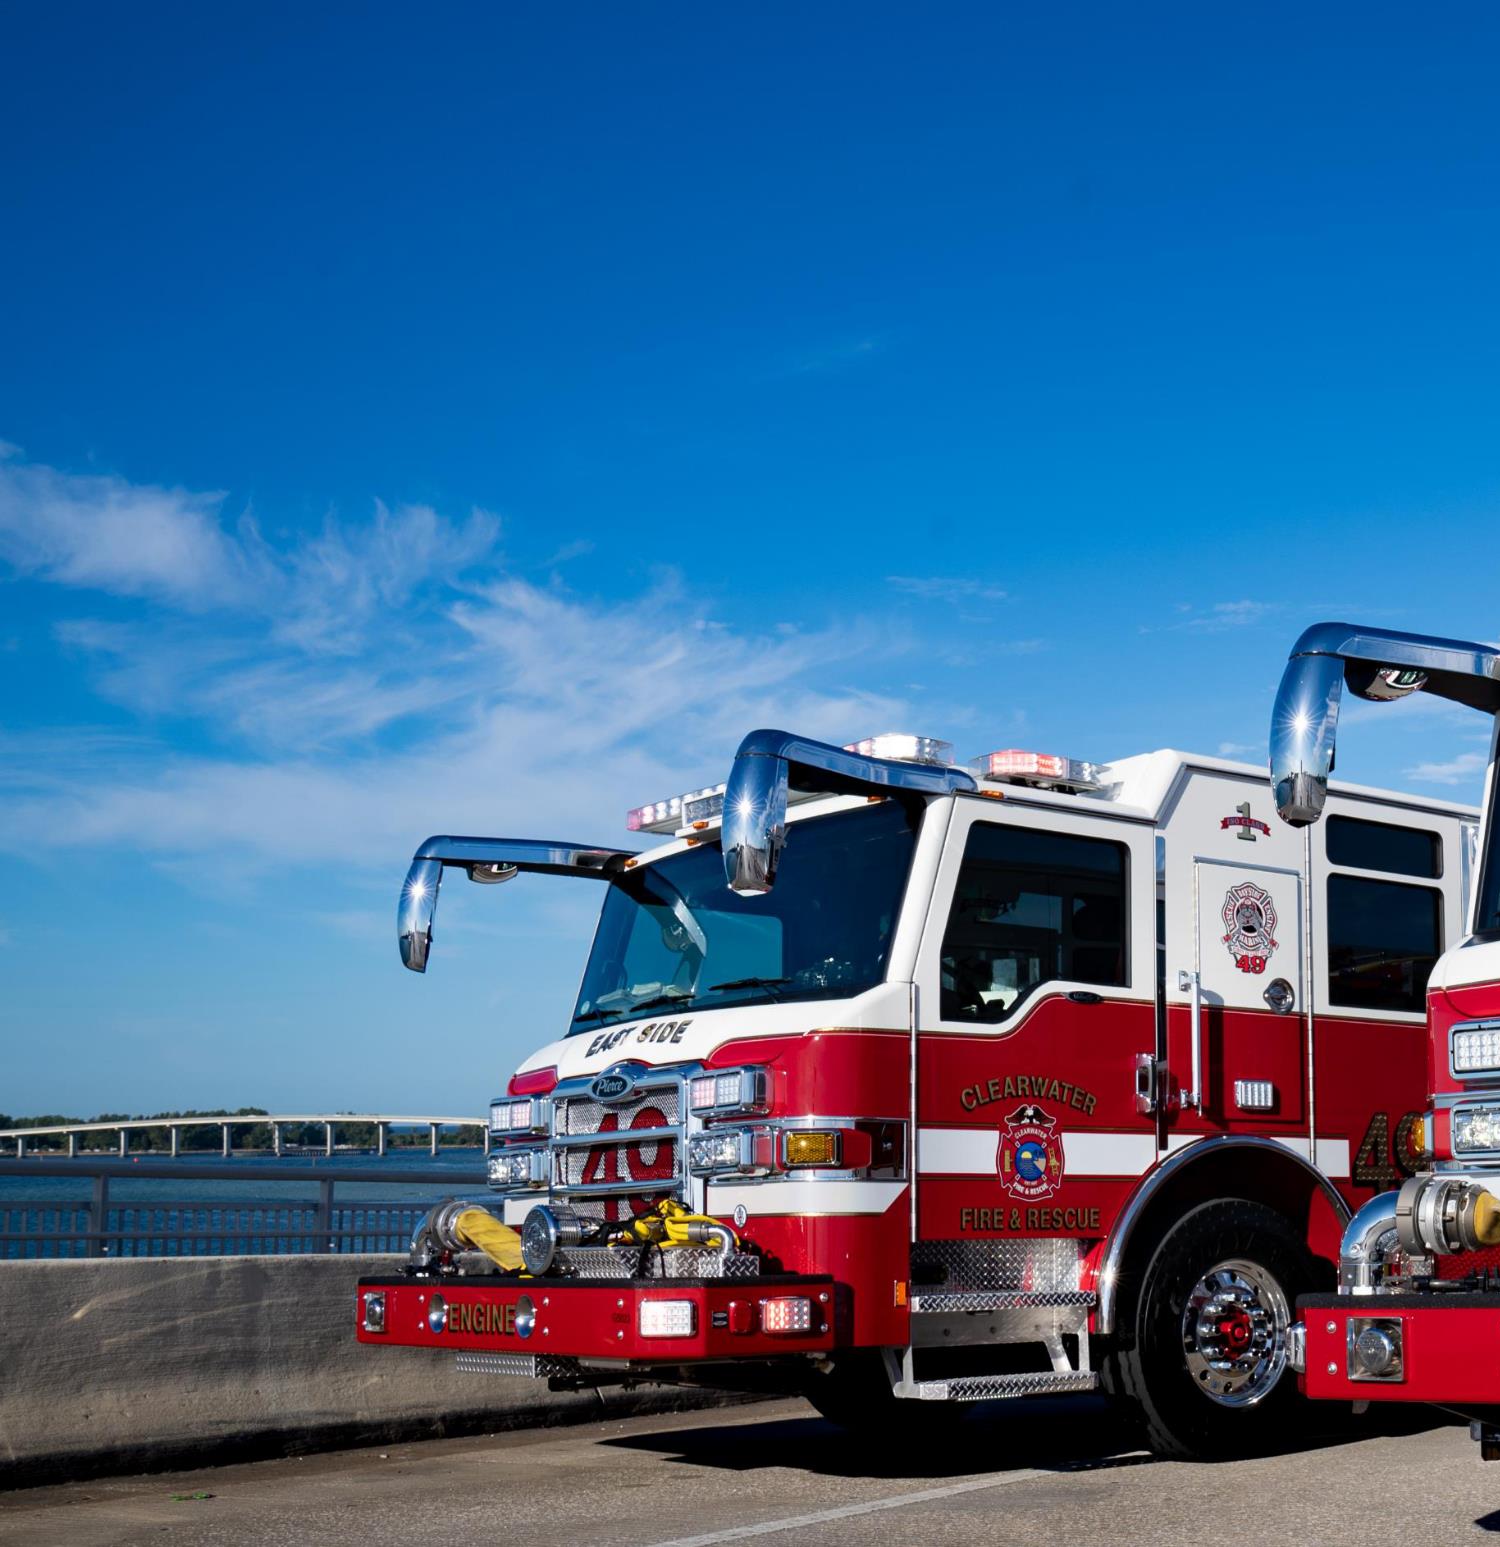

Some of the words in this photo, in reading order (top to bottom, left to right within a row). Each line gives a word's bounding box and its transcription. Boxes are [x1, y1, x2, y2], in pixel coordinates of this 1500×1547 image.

[1236, 955, 1266, 974] 49
[585, 1026, 638, 1058] EAST
[637, 1019, 694, 1044] SIDE
[596, 1077, 624, 1096] Pierce
[960, 1075, 1098, 1116] CLEARWATER
[1014, 1127, 1048, 1140] CLEARWATER
[960, 1207, 1004, 1231] FIRE
[1009, 1207, 1022, 1230] &
[1026, 1207, 1100, 1230] RESCUE
[448, 1303, 516, 1335] ENGINE
